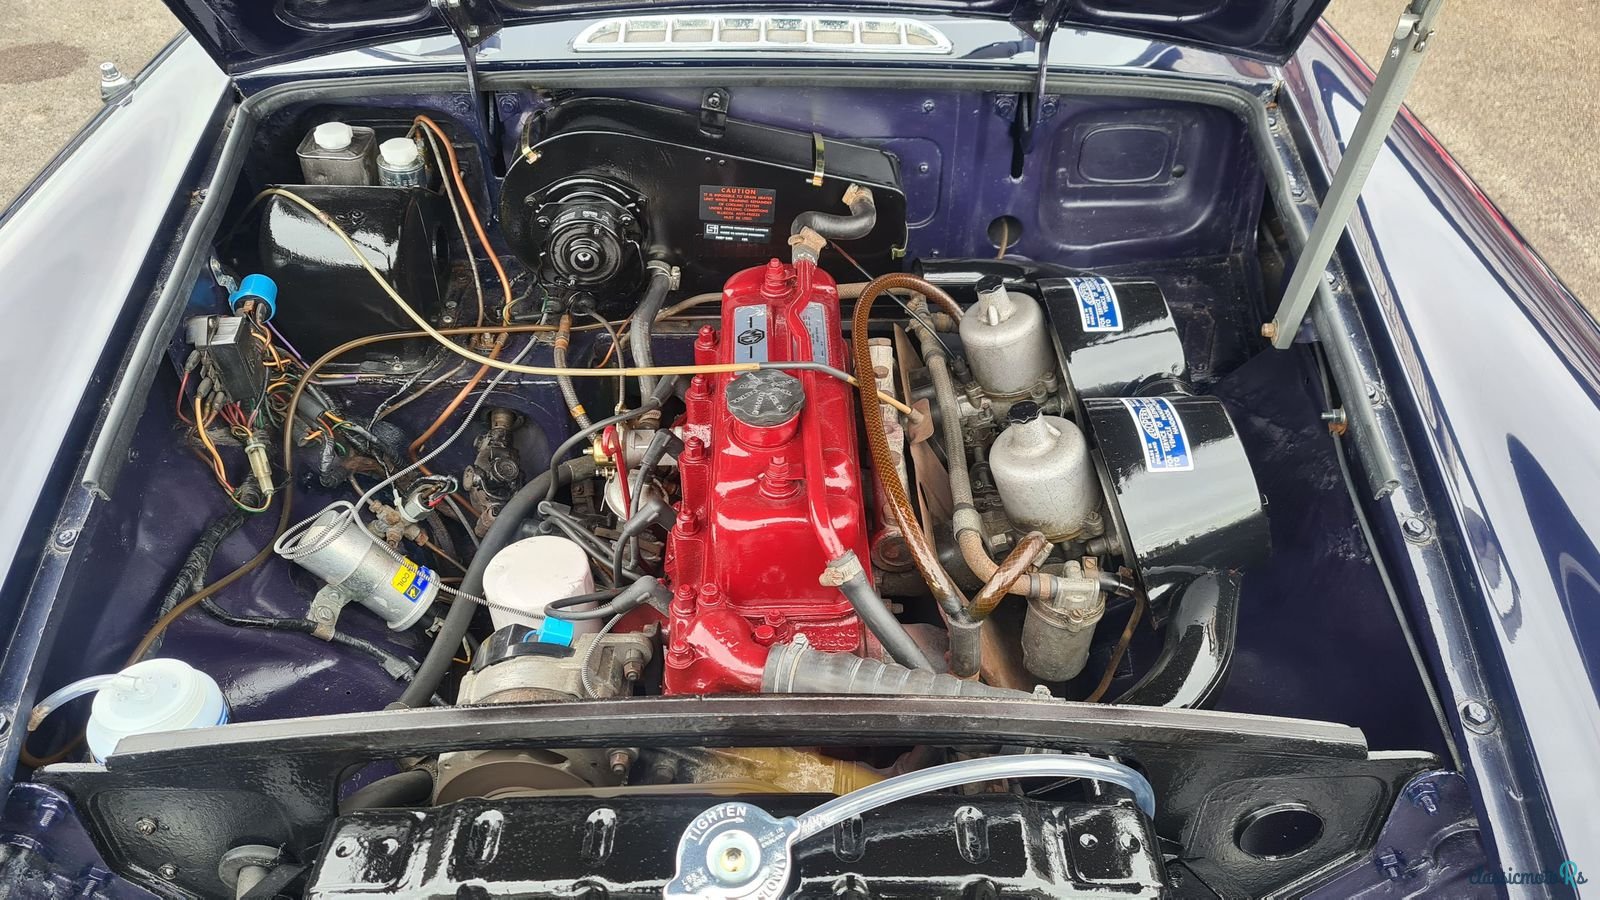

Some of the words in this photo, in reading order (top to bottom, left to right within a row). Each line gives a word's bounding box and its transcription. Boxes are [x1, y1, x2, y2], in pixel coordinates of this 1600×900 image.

[1164, 409, 1179, 434] HANDBOOK
[1160, 431, 1171, 452] SERVICE
[1165, 426, 1176, 449] VEHICLE
[397, 572, 410, 587] COIL
[686, 806, 747, 841] TIGHTEN
